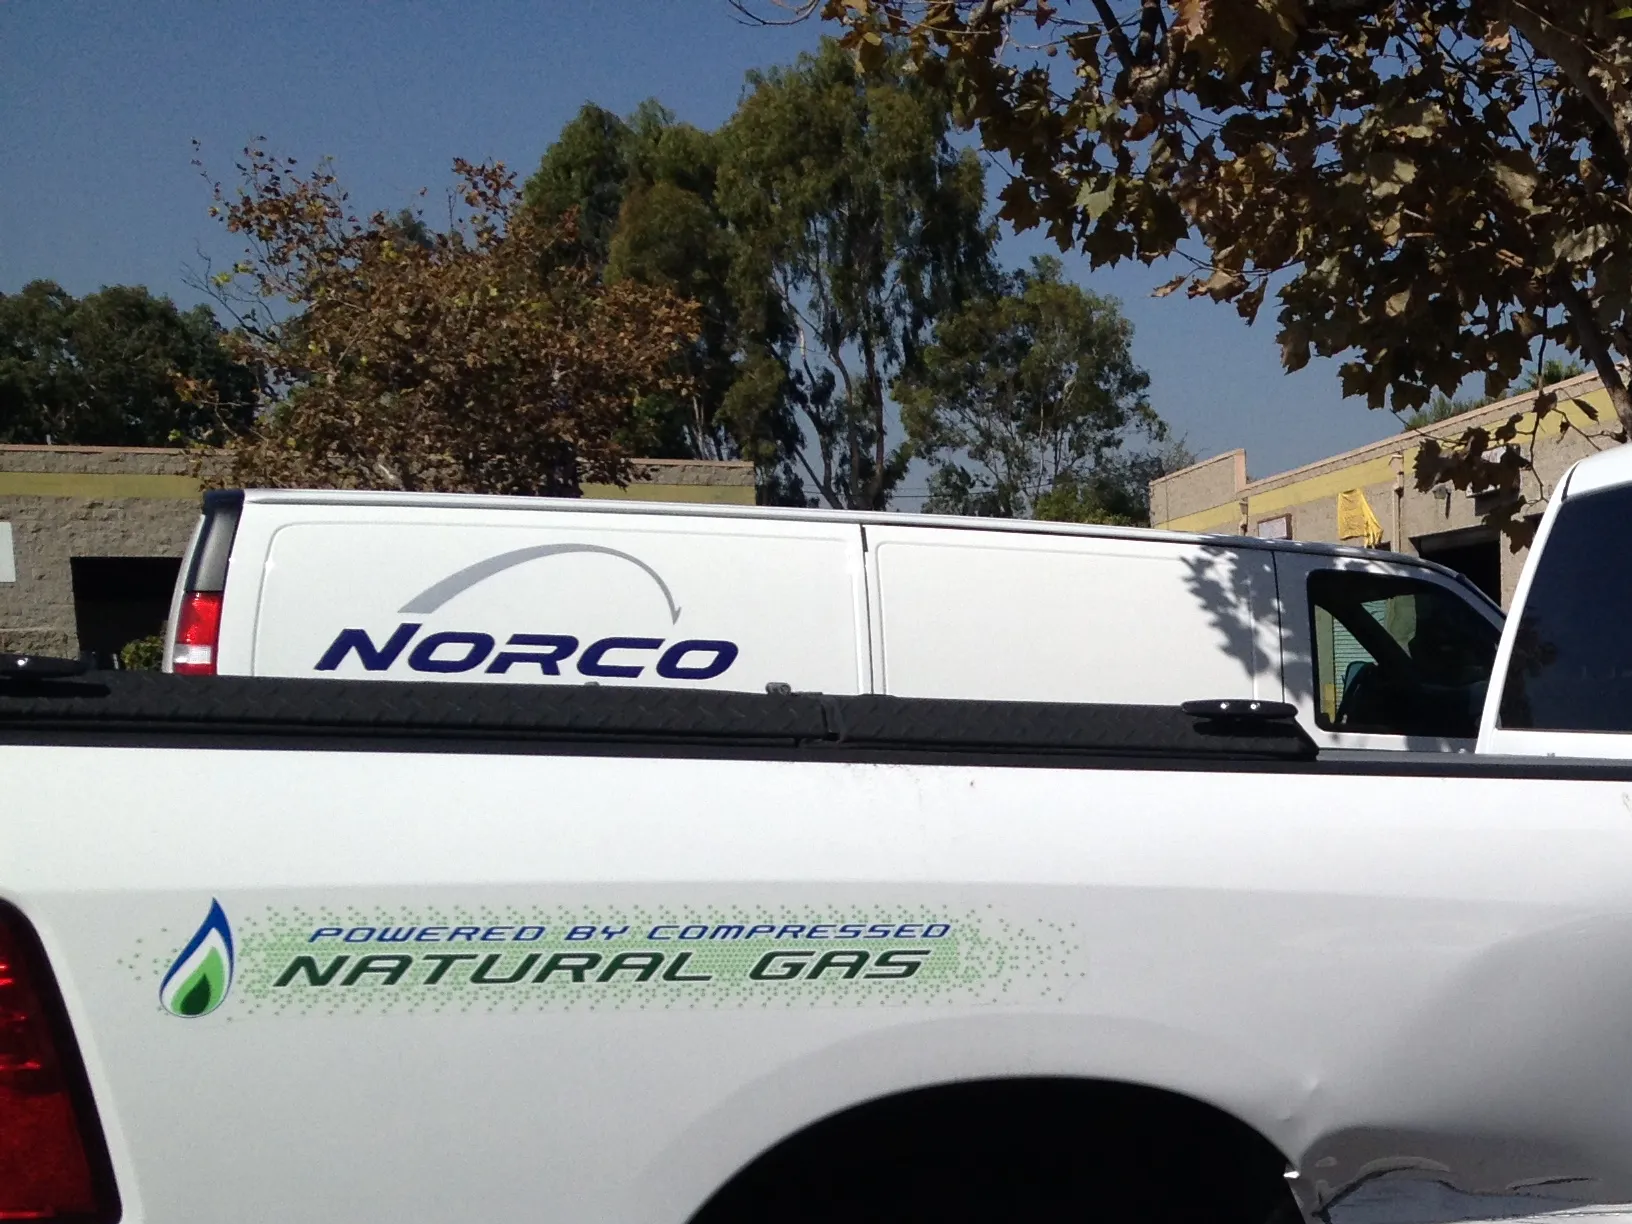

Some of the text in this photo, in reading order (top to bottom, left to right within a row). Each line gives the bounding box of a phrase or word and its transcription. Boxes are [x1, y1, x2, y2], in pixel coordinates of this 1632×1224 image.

[313, 622, 739, 680] NORCO
[308, 924, 951, 943] POWERED BY COMPRESSED
[272, 950, 932, 987] NATURAL GAS
